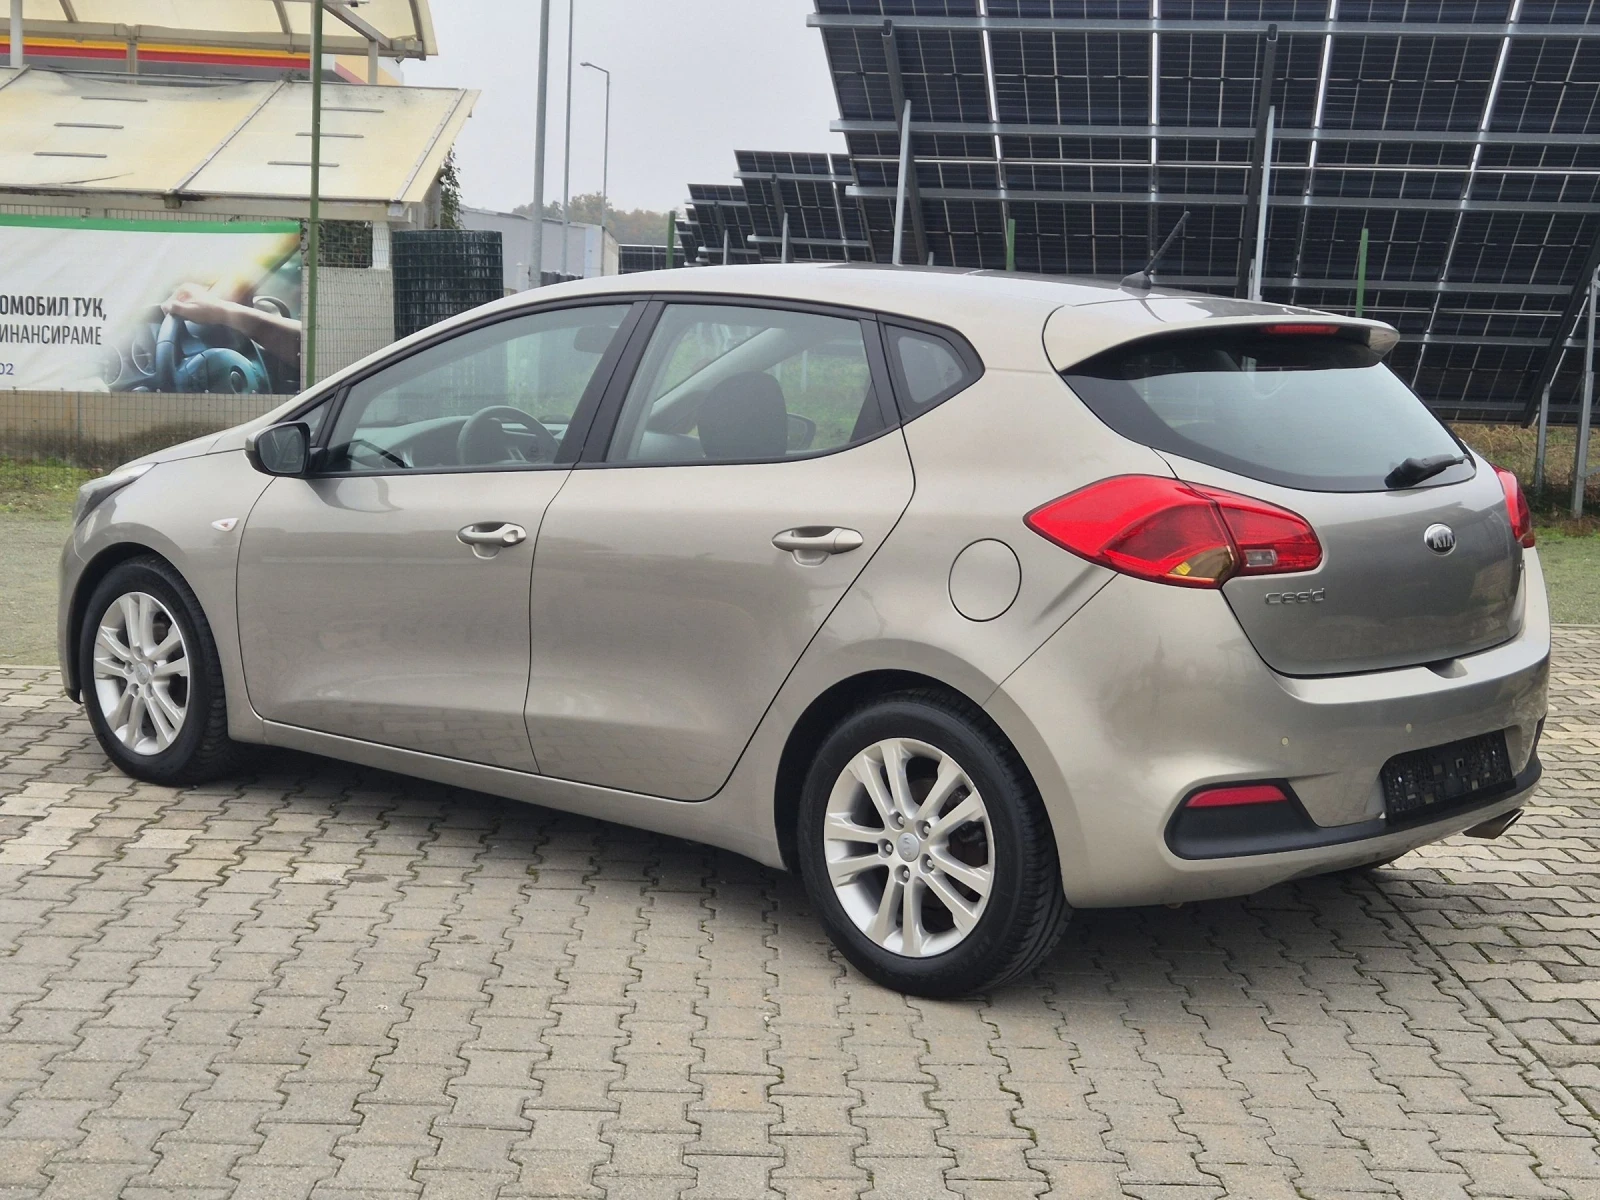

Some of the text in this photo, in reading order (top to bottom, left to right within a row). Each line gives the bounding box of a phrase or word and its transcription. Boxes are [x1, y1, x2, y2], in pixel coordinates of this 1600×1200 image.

[0, 295, 107, 321] ОМОБИЛ ТУК,
[0, 324, 102, 345] ИНАНСИРАМЕ
[1433, 532, 1454, 549] KIA
